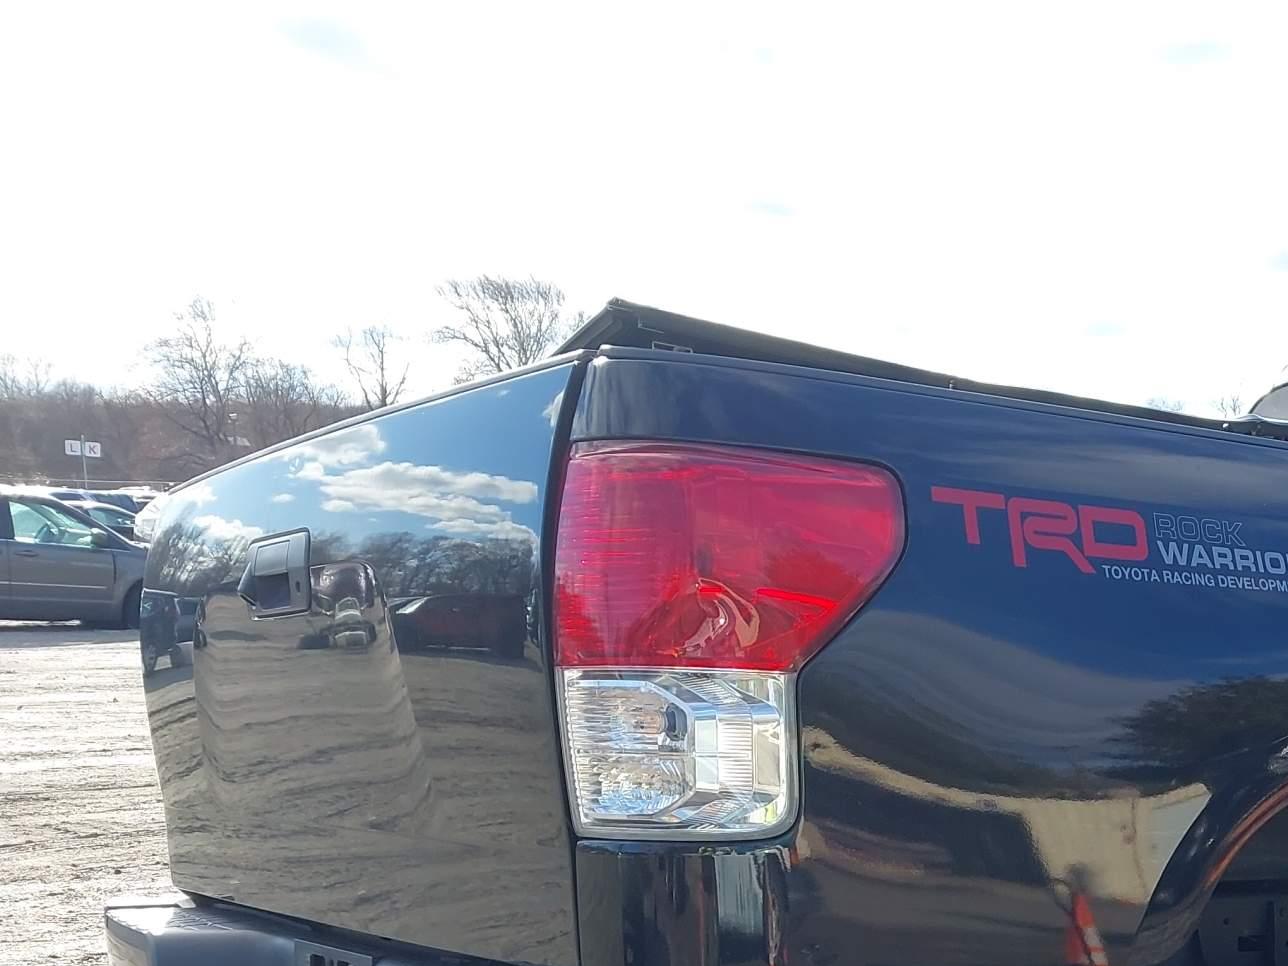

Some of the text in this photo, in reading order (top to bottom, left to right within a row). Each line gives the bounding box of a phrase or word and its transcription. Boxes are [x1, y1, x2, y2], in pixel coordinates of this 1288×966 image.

[70, 443, 79, 452] L
[88, 445, 97, 454] K
[931, 486, 1148, 573] TRD
[1153, 512, 1244, 546] ROCK
[1102, 564, 1161, 583] TOYOTA
[1162, 569, 1216, 588] RACING
